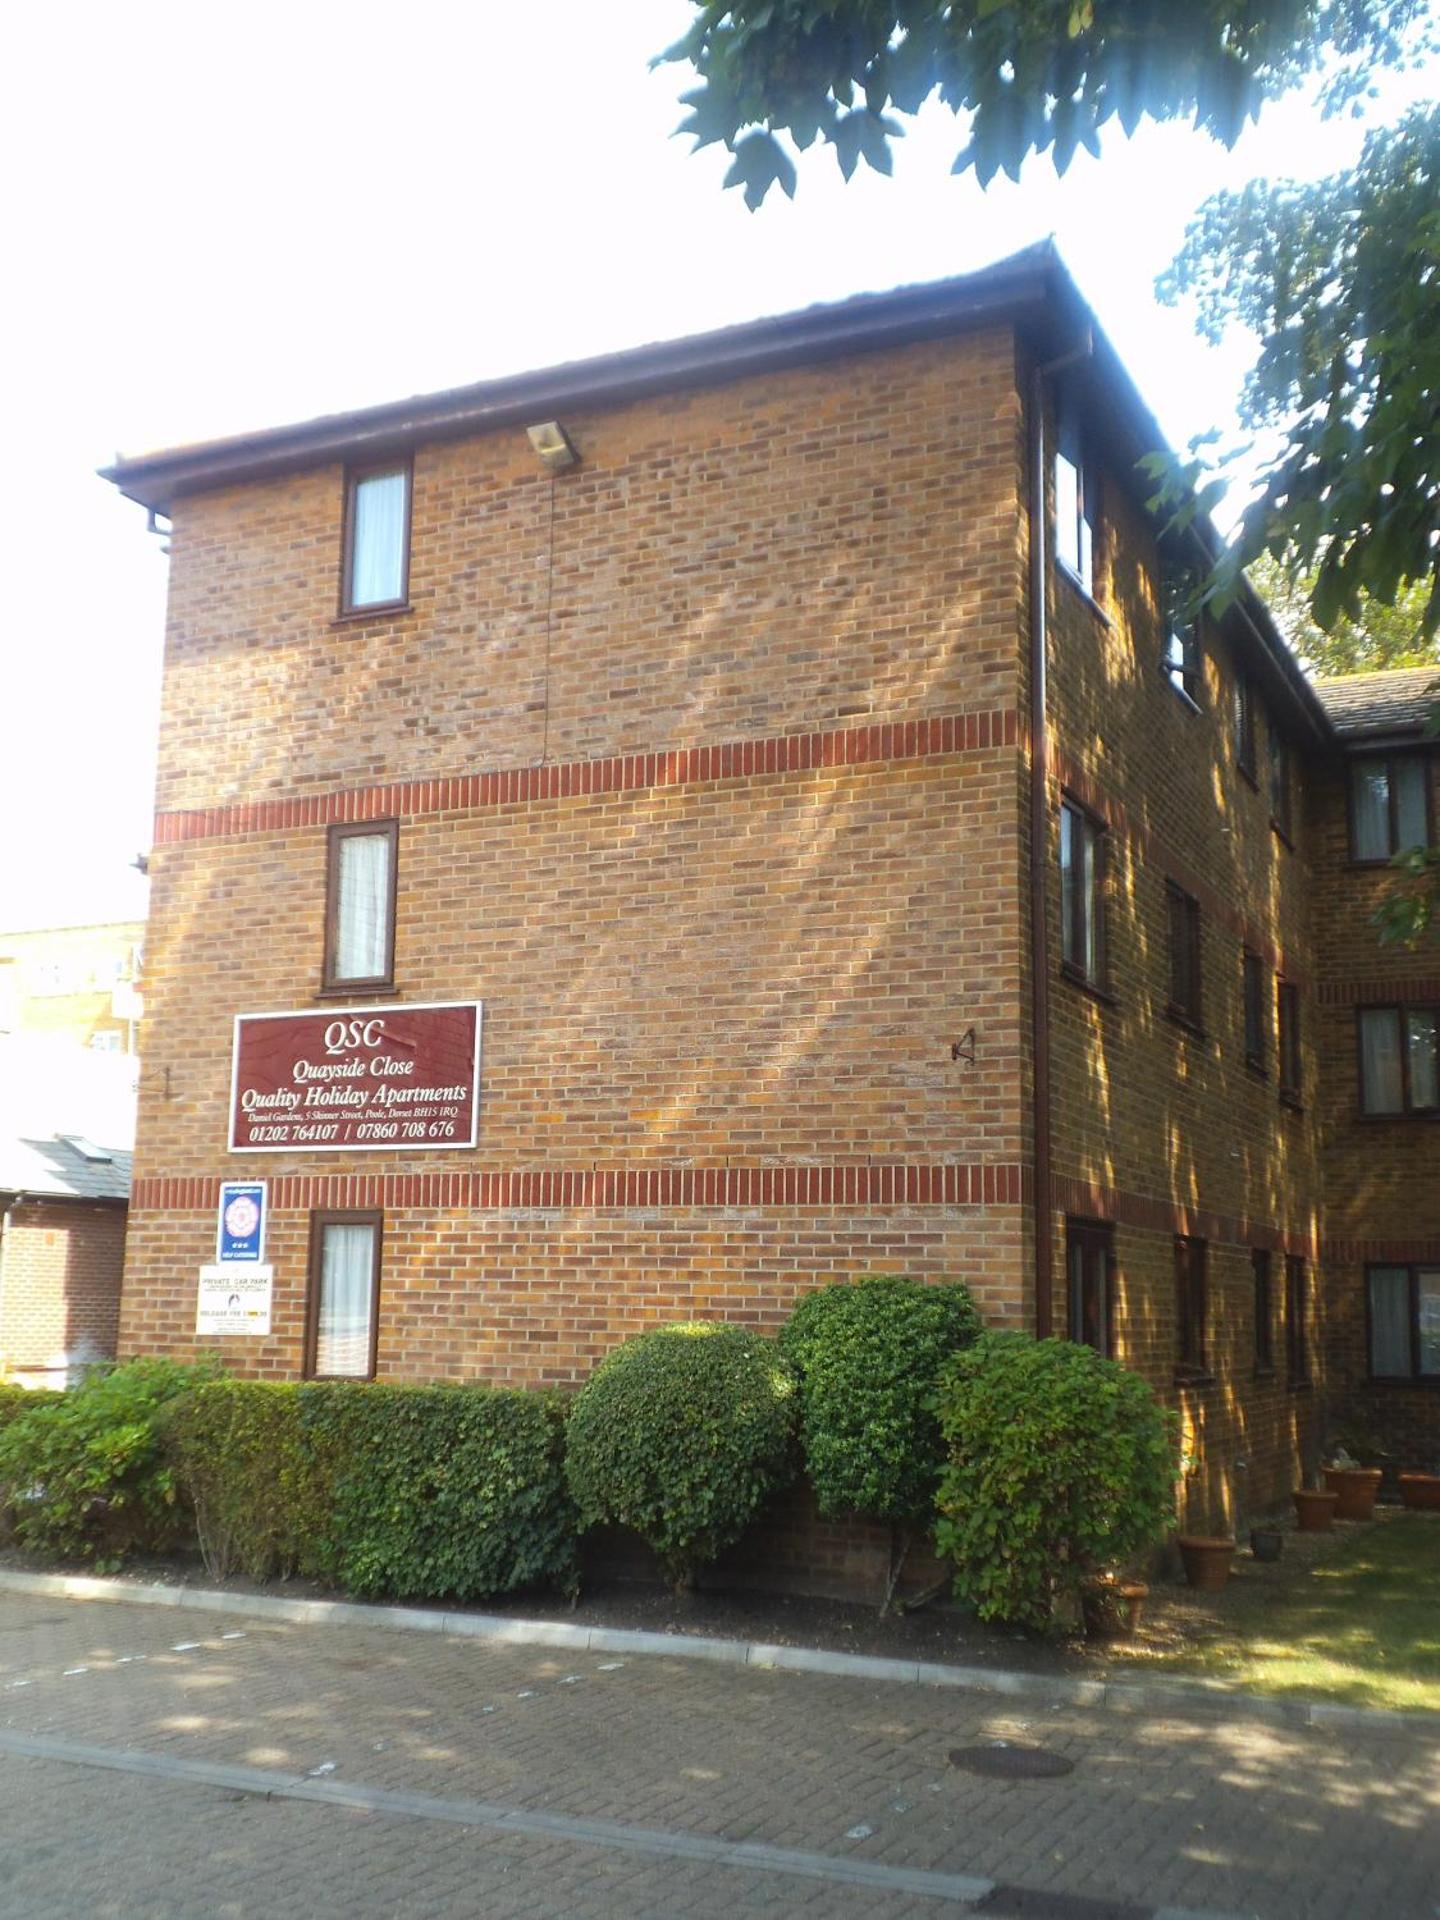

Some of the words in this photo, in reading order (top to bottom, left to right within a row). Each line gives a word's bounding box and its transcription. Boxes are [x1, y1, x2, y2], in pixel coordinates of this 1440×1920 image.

[325, 1019, 385, 1054] QSC
[293, 1058, 366, 1083] Quayside
[370, 1055, 414, 1076] Close
[241, 1087, 301, 1112] Quality
[304, 1085, 369, 1108] Holiday
[371, 1083, 467, 1107] Apartments
[388, 1108, 412, 1119] Dorset
[413, 1107, 437, 1118] BH15
[249, 1125, 288, 1142] 01202
[292, 1124, 339, 1141] 764107
[344, 1123, 351, 1141] /
[356, 1122, 398, 1139] 07860
[401, 1121, 426, 1138] 708
[428, 1120, 455, 1137] 676
